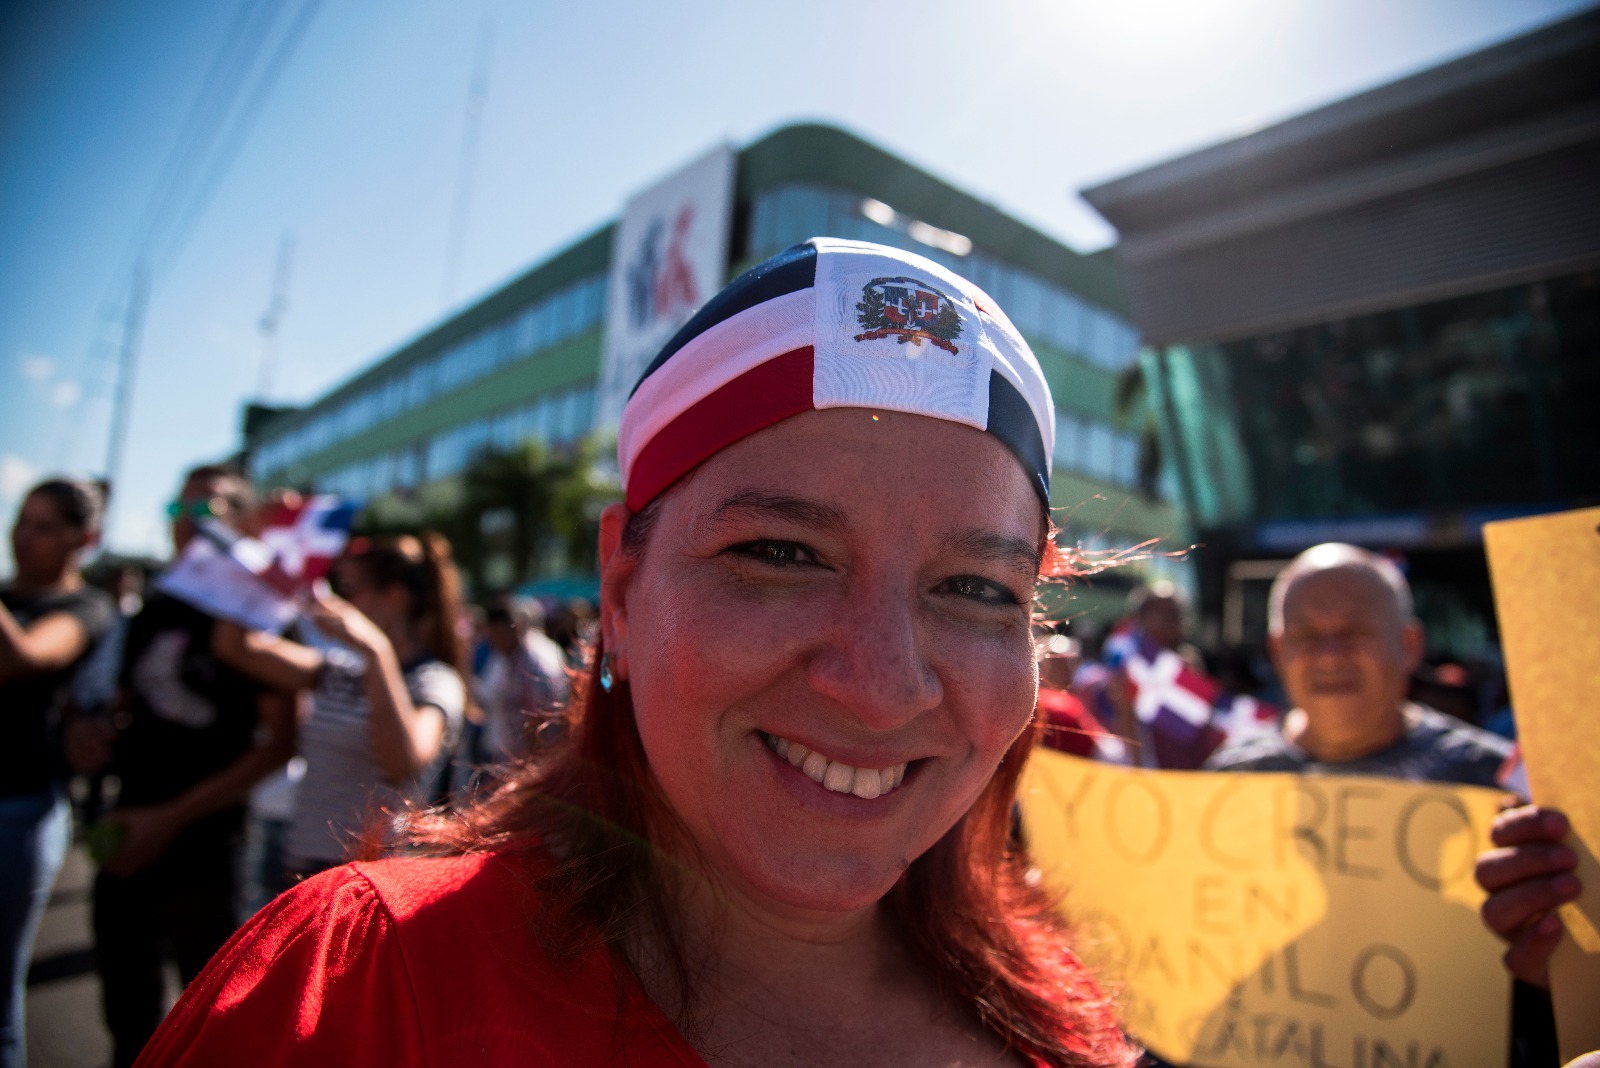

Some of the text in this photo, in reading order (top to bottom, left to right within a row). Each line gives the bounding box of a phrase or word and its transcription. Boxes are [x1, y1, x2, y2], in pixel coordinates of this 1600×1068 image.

[1036, 766, 1478, 892] YO CREO
[1191, 874, 1299, 936] EN
